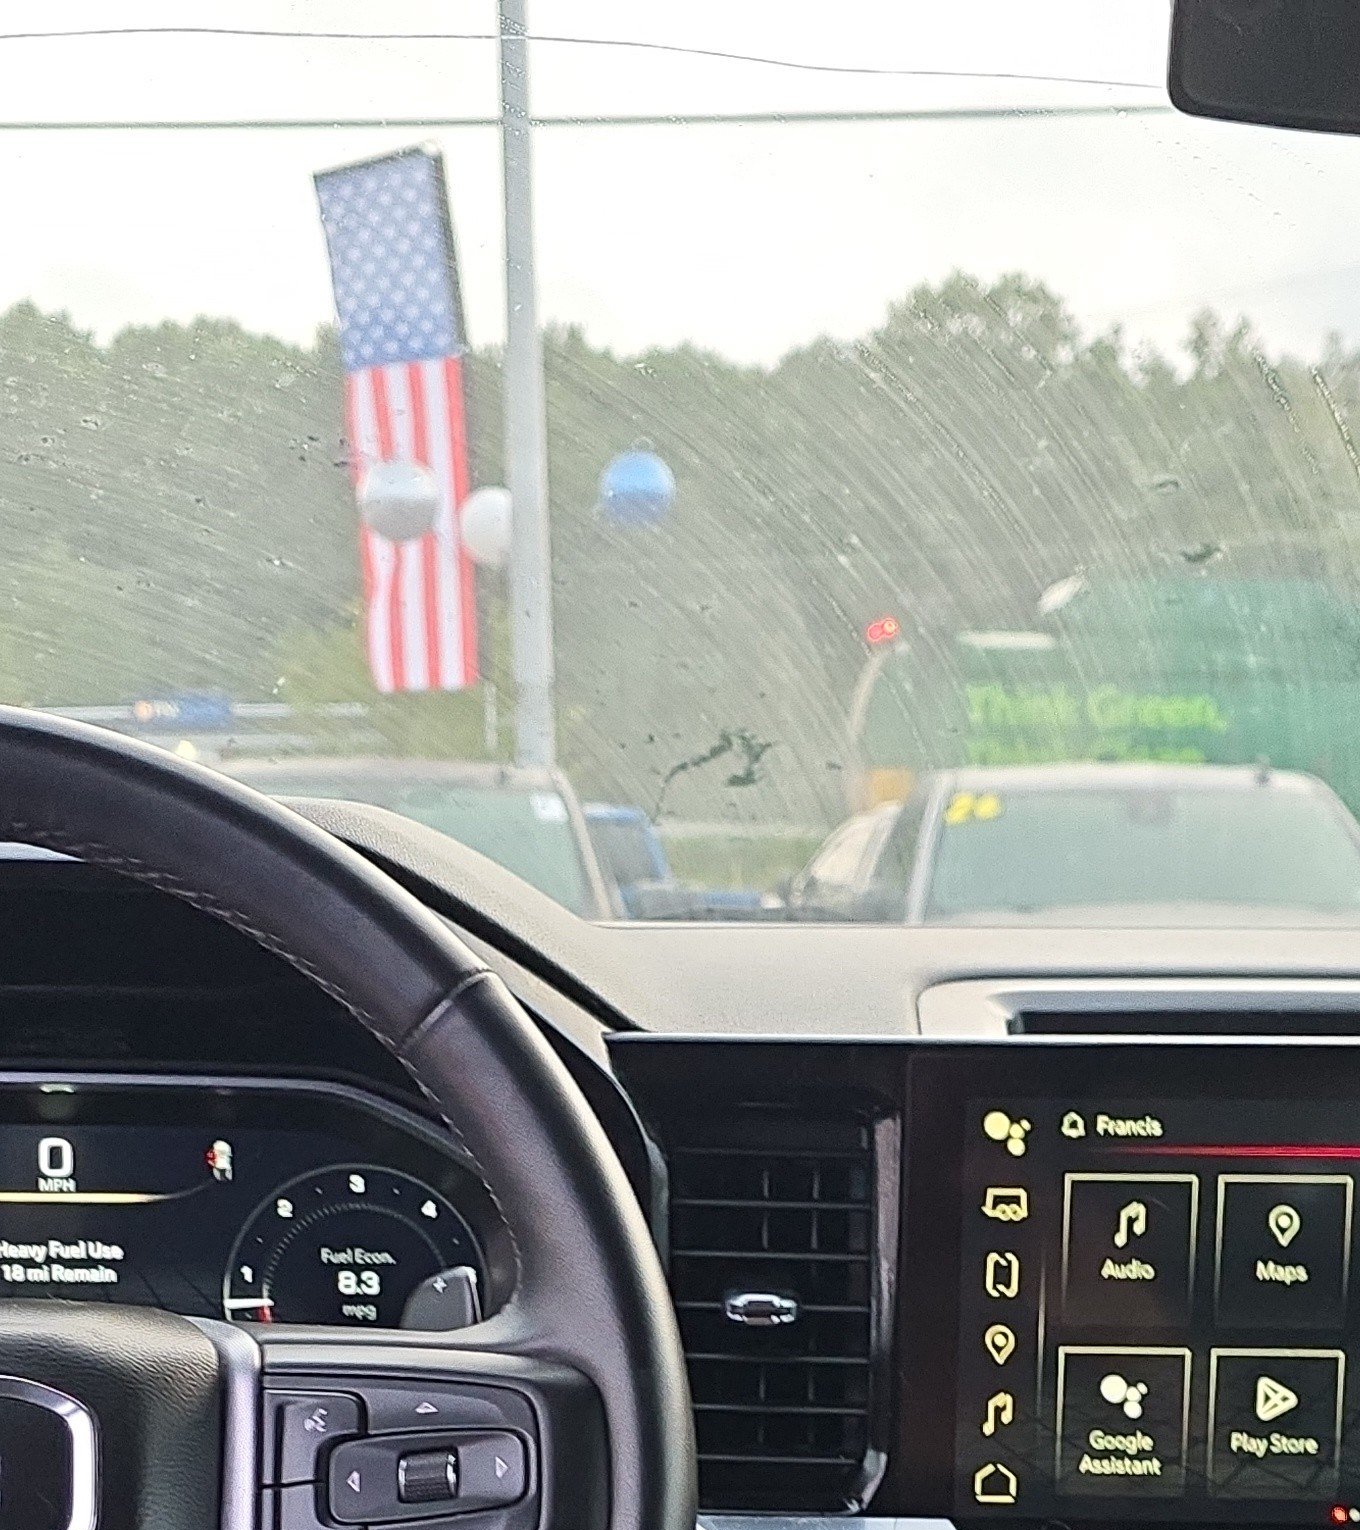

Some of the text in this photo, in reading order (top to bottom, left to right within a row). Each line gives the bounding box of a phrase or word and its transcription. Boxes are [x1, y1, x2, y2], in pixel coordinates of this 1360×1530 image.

[1096, 1113, 1163, 1137] Francis
[38, 1136, 75, 1179] 0
[39, 1177, 77, 1193] MPH
[48, 1239, 85, 1261] Fuel
[88, 1240, 125, 1261] Use
[320, 1248, 352, 1265] Fuel
[2, 1265, 24, 1282] 18
[51, 1264, 118, 1283] Remain
[1100, 1258, 1155, 1280] Audio
[1256, 1260, 1308, 1286] Maps
[1088, 1430, 1154, 1455] Google
[1230, 1431, 1319, 1458] Play Store
[1078, 1454, 1162, 1476] Assistant
